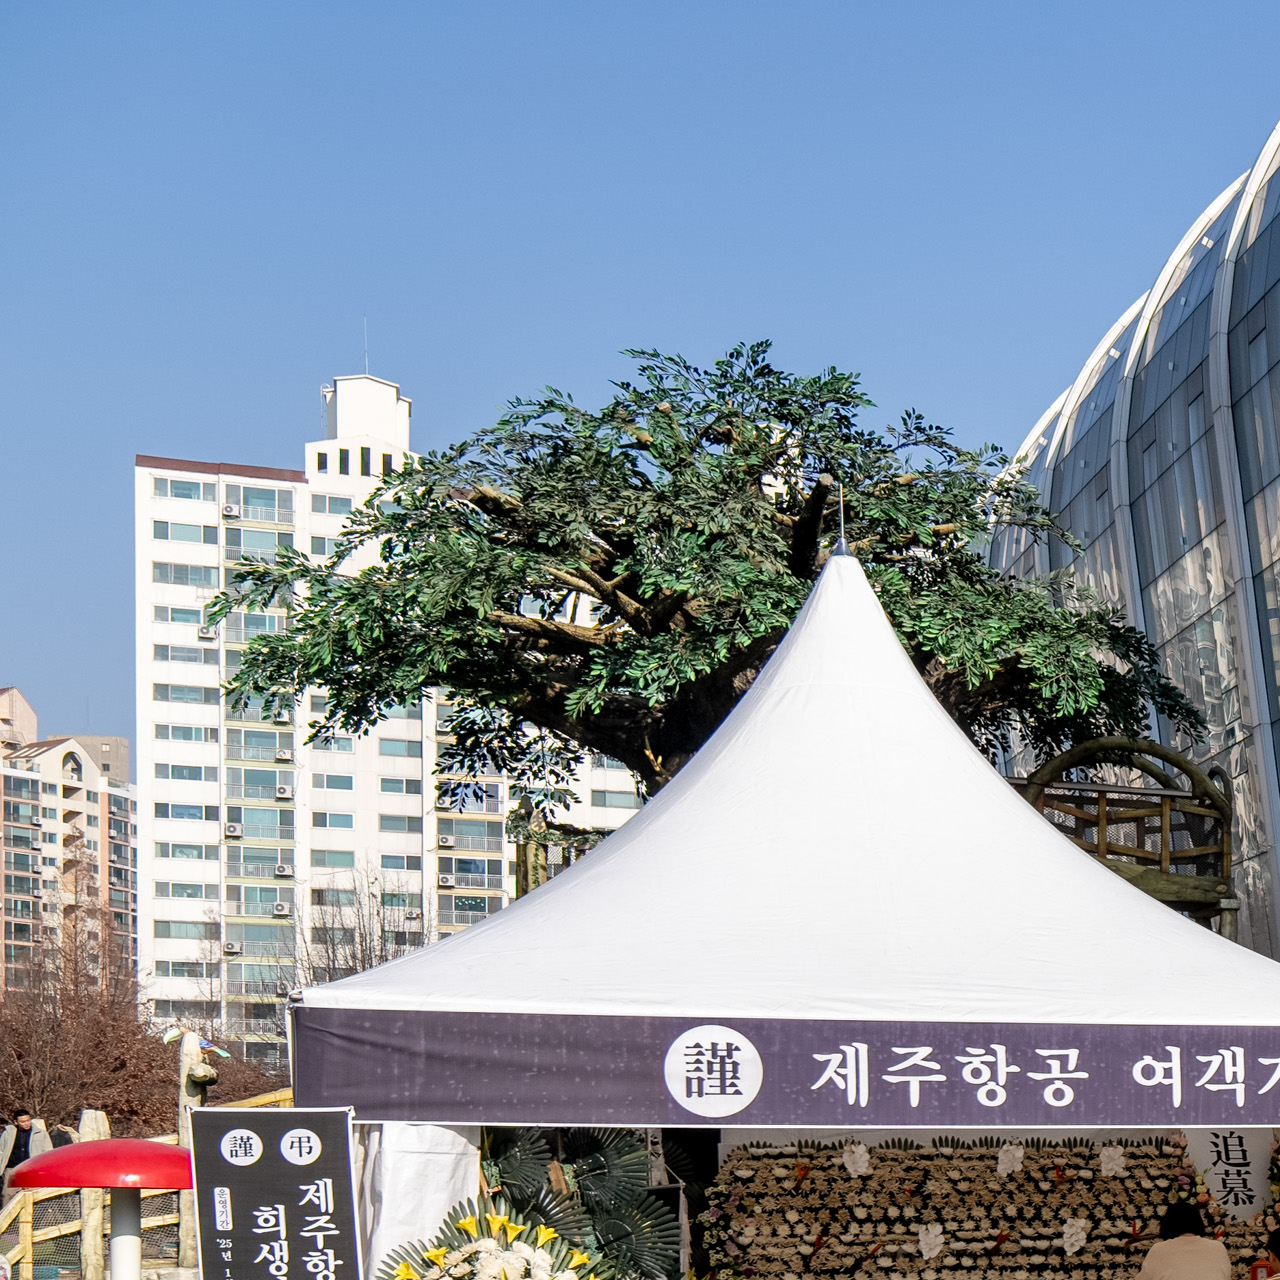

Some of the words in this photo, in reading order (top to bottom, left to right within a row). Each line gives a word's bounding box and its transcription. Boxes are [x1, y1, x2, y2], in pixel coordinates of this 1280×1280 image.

[683, 1042, 745, 1098] 謹
[810, 1043, 1088, 1108] 제주항공
[229, 1136, 254, 1158] 謹
[289, 1136, 313, 1158] 弔
[1209, 1131, 1257, 1206] 追慕
[217, 1188, 230, 1230] 운영기간
